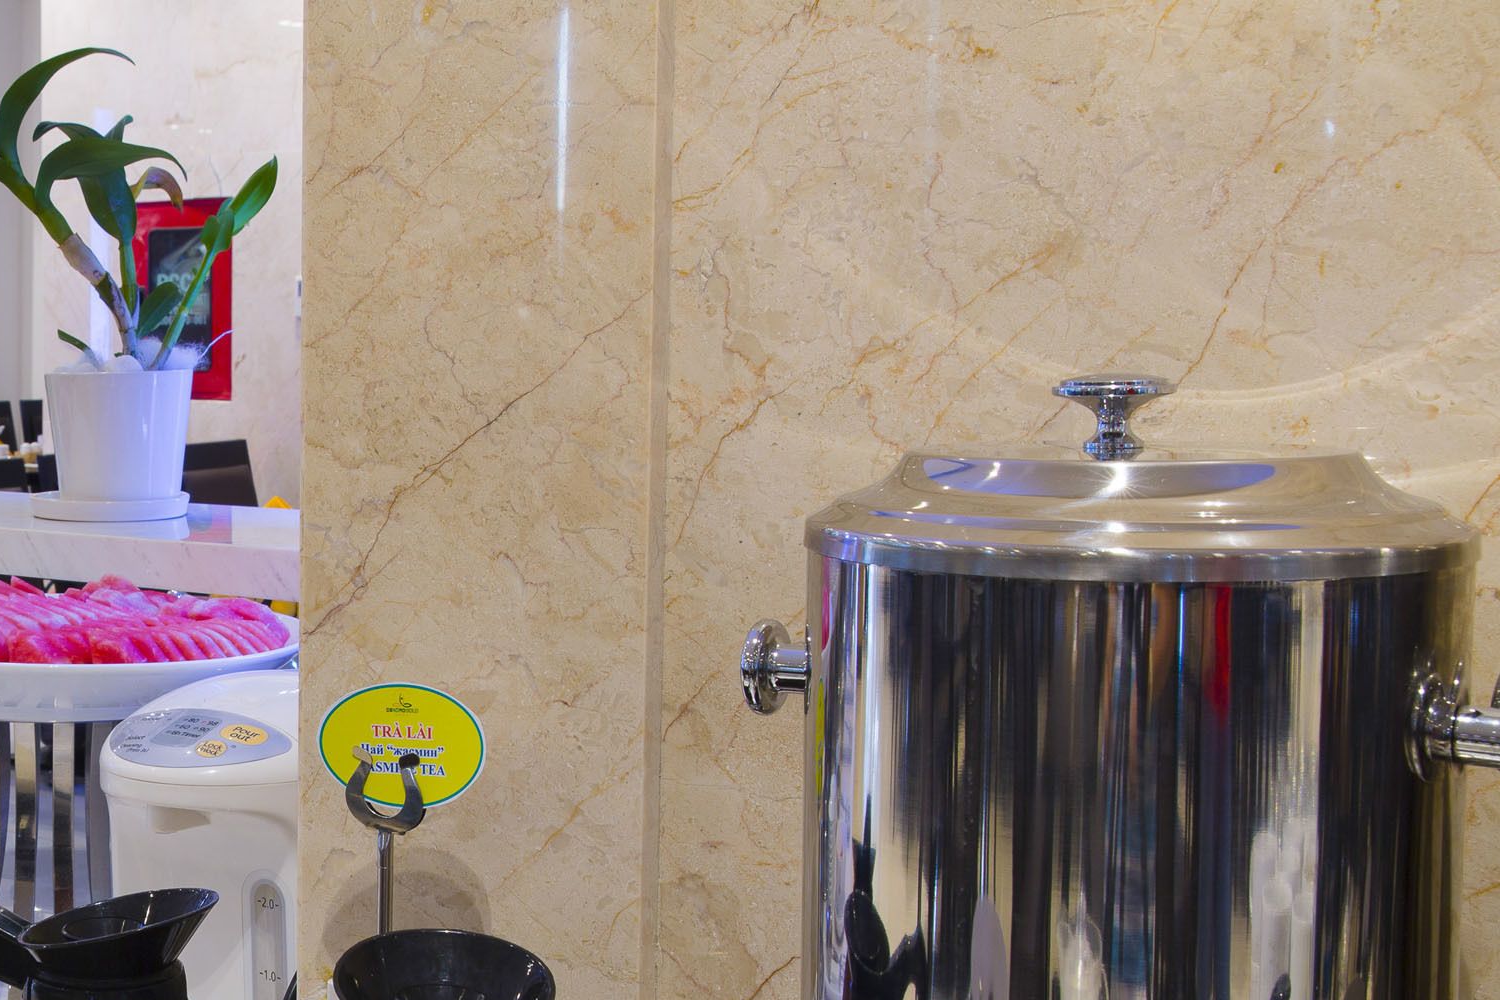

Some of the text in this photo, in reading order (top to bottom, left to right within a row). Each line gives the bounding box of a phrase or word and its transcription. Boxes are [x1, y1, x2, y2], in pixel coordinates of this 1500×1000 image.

[230, 732, 250, 742] out
[372, 722, 432, 739] TRÀ LÀI
[420, 764, 445, 776] TEA
[262, 897, 275, 910] 2.0
[264, 970, 277, 983] 1.0
